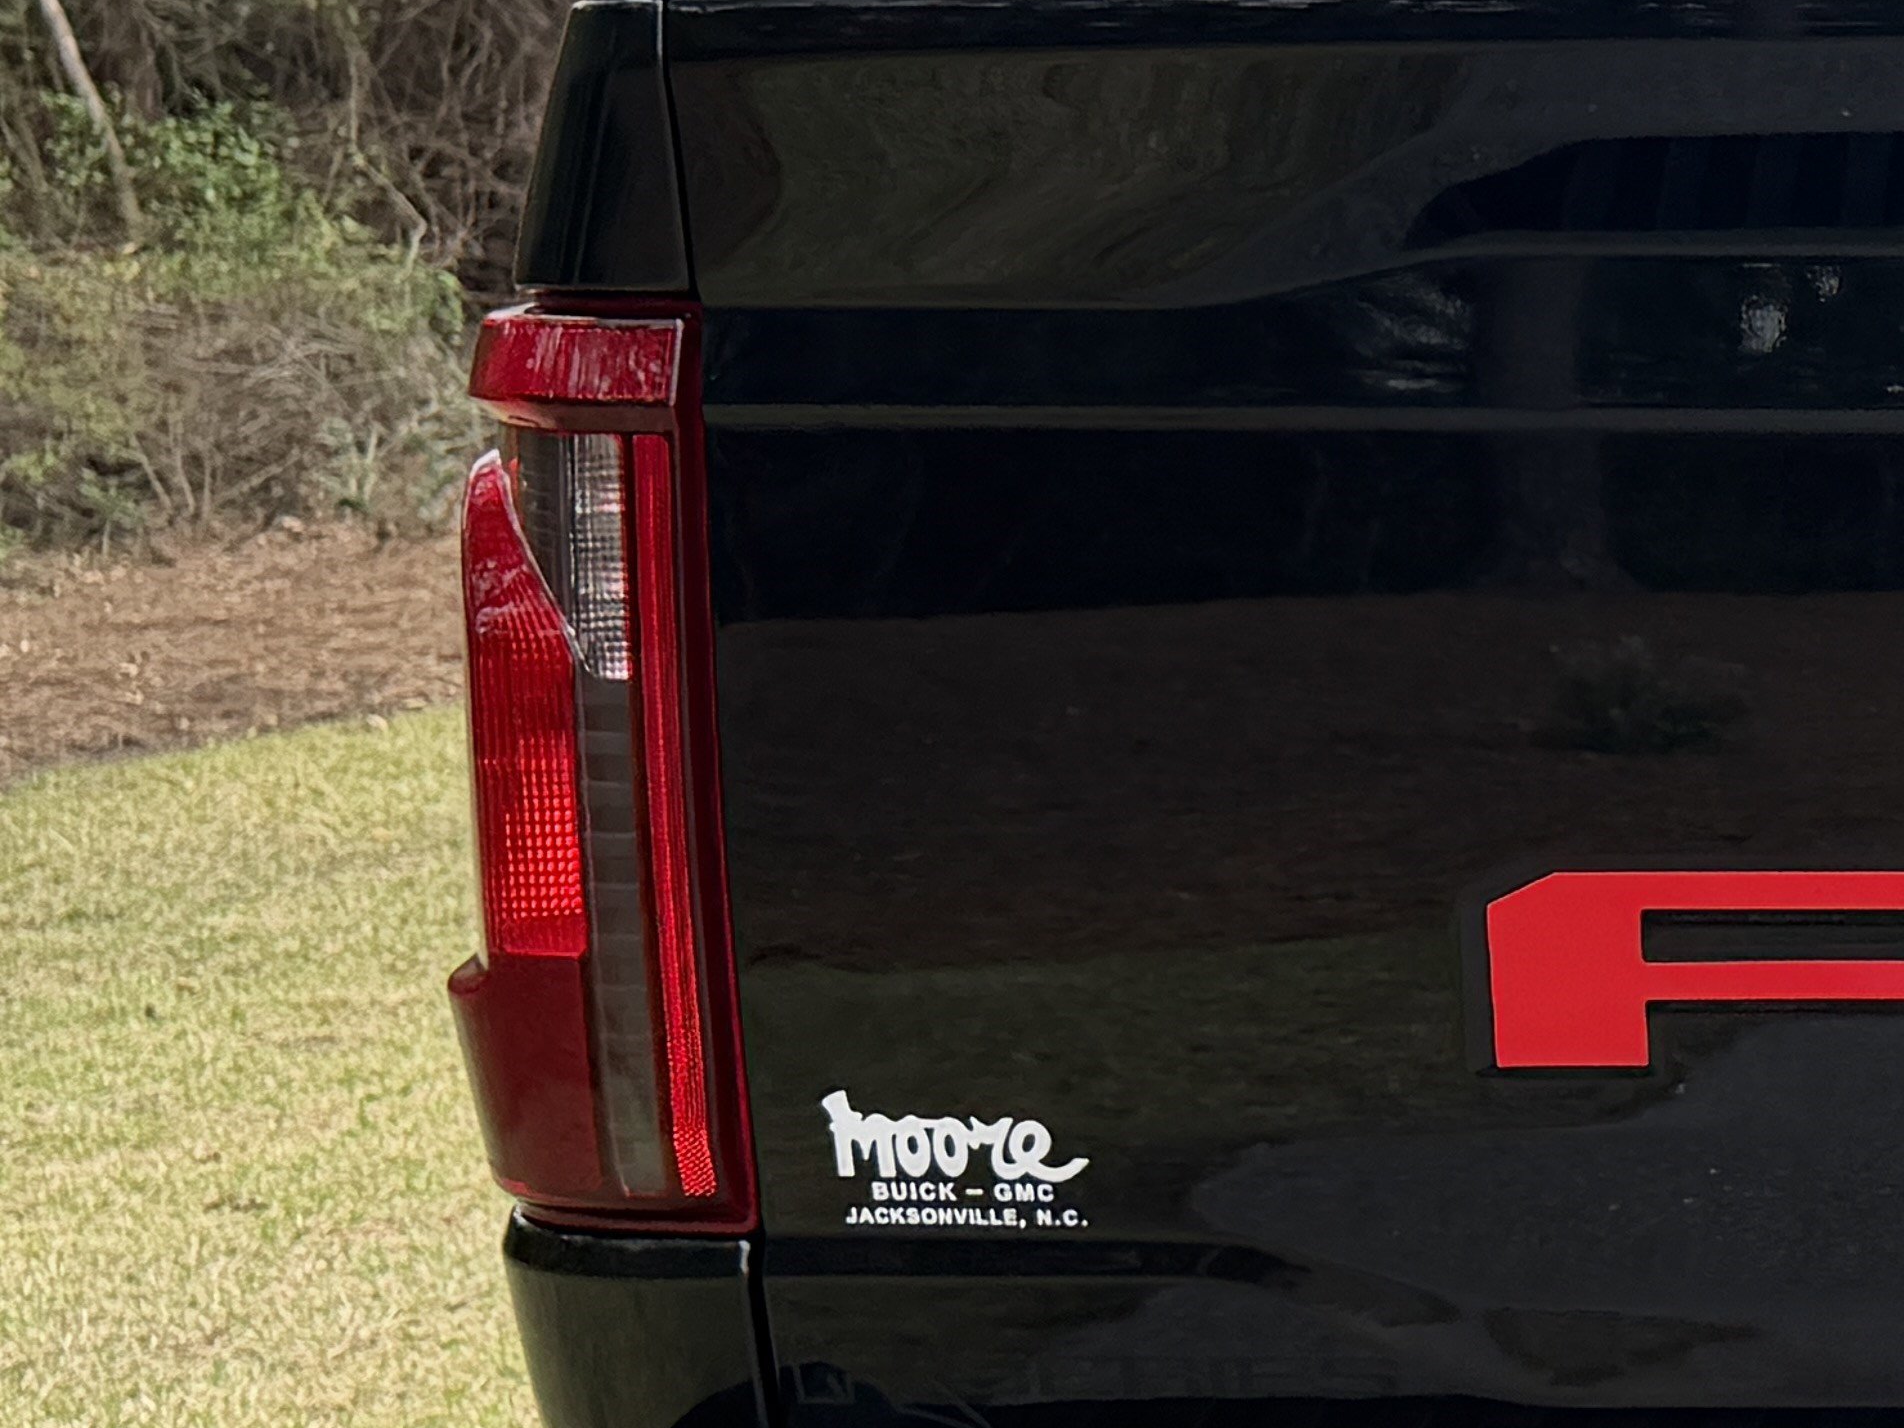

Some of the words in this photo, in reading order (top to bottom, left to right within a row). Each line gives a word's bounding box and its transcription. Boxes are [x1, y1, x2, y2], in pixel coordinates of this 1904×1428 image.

[871, 1181, 958, 1202] BUICK
[993, 1182, 1055, 1203] GMC
[845, 1206, 1027, 1229] JACKSONVILLE,
[1036, 1208, 1090, 1228] N.C.
